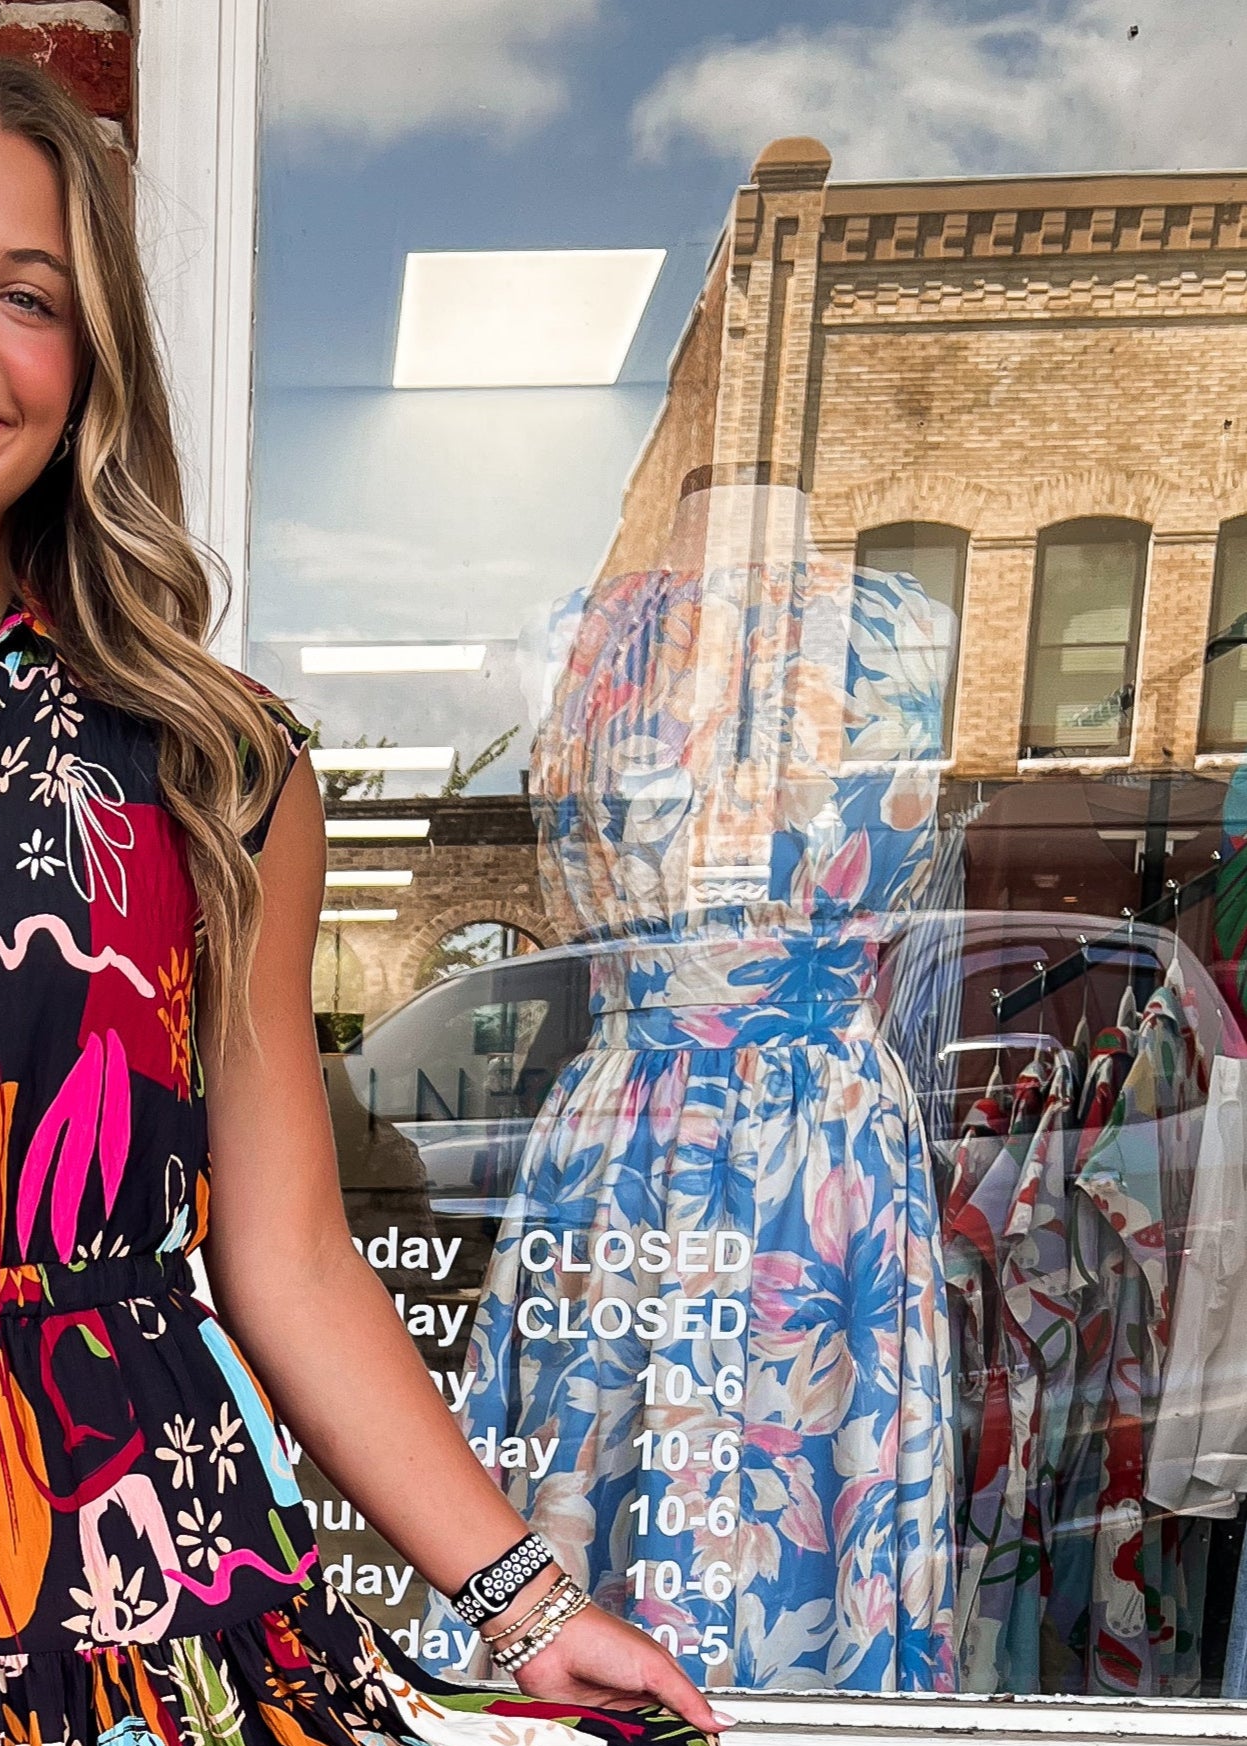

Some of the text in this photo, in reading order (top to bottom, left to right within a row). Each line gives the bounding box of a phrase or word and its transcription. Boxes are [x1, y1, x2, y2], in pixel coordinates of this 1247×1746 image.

[520, 1229, 751, 1273] CLOSED
[517, 1297, 748, 1340] CLOSED
[636, 1363, 744, 1407] 10-6
[468, 1426, 741, 1480] day 10-6
[629, 1494, 736, 1537] 10-6
[322, 1554, 733, 1606] day 10-6
[383, 1618, 729, 1671] day 0-5
